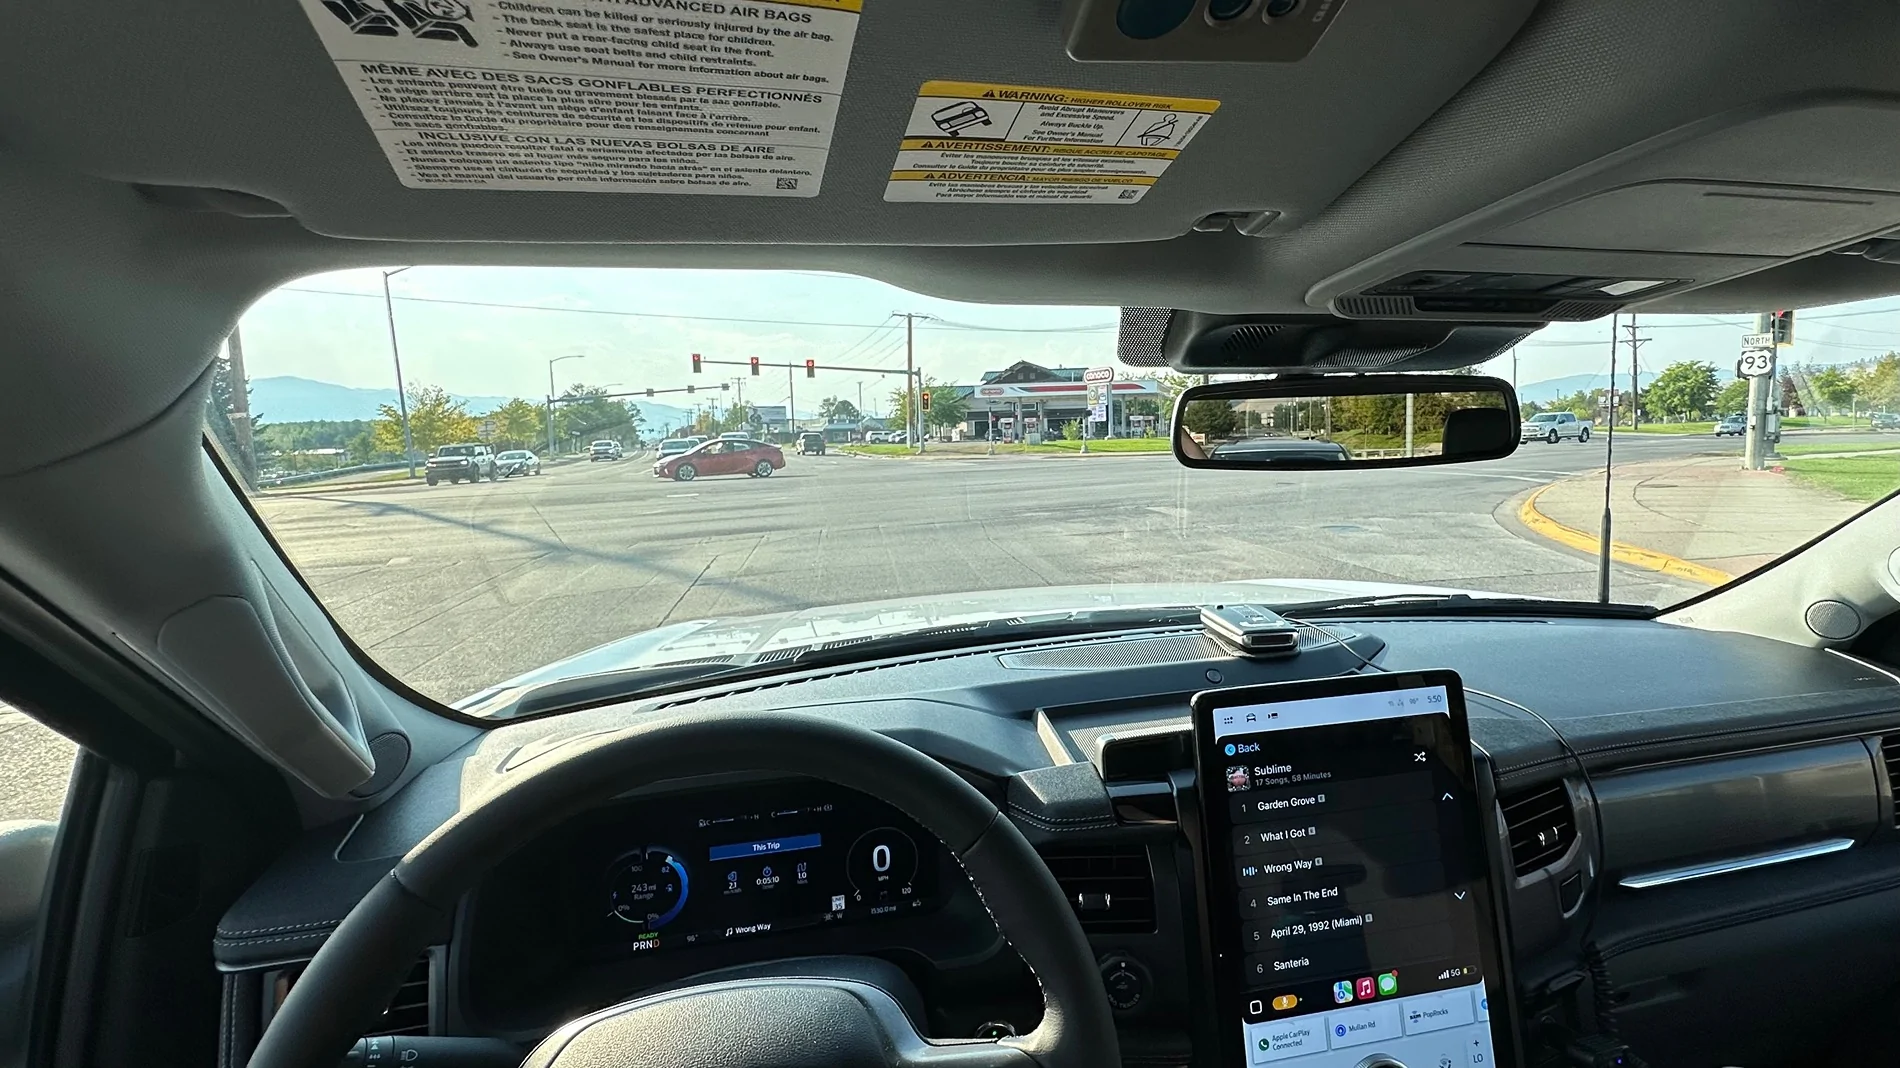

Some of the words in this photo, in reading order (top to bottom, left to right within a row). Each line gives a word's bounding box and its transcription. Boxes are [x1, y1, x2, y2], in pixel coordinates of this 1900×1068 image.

[498, 1, 554, 15] Children
[558, 7, 582, 17] can
[584, 9, 600, 18] be
[604, 12, 638, 22] killed
[658, 18, 710, 30] seriously
[714, 22, 753, 34] injured
[756, 26, 770, 36] by
[772, 28, 790, 38] the
[794, 30, 808, 38] air
[811, 32, 834, 42] bag.
[730, 7, 760, 18] AIR
[764, 9, 812, 24] BAGS
[503, 14, 528, 25] The
[530, 16, 562, 28] back
[566, 20, 594, 30] seat
[596, 22, 608, 32] is
[610, 24, 632, 34] the
[634, 26, 670, 37] safest
[674, 31, 704, 40] place
[708, 33, 724, 42] for
[728, 35, 775, 46] children.
[505, 26, 542, 38] Never
[546, 31, 568, 40] put
[582, 34, 648, 48] rear-facing
[652, 39, 680, 50] child
[683, 44, 708, 52] seat
[710, 45, 722, 53] in
[724, 46, 742, 54] the
[745, 48, 774, 58] front.
[509, 40, 556, 52] Always
[558, 44, 581, 52] use
[584, 46, 610, 55] seat
[612, 48, 642, 58] belts
[645, 51, 666, 60] and
[670, 52, 696, 62] child
[700, 56, 756, 67] restraints.
[512, 51, 536, 60] See
[539, 54, 589, 64] Owner's
[592, 58, 636, 68] Manual
[638, 60, 654, 70] for
[657, 64, 686, 72] more
[689, 65, 751, 77] information
[754, 70, 784, 80] about
[786, 72, 800, 80] air
[802, 74, 830, 84] bags.
[360, 64, 422, 76] MÊME
[426, 68, 478, 80] AVEC
[482, 72, 520, 83] DES
[524, 74, 574, 86] SACS
[578, 78, 692, 94] GONFLABLES
[696, 86, 822, 104] PERFECTIONNÉS
[998, 90, 1068, 103] WARNING:
[1070, 96, 1104, 105] HIGHER
[1104, 99, 1152, 108] ROLLOVER
[1056, 112, 1092, 120] Excessive
[1092, 114, 1115, 122] Speed.
[1061, 106, 1086, 116] Abrupt
[1088, 107, 1125, 116] Maneuvers
[1040, 121, 1068, 129] Always
[1069, 122, 1092, 130] Buckle
[1093, 122, 1104, 130] Up.
[1036, 135, 1064, 143] Further
[1064, 136, 1104, 144] Information
[1047, 130, 1076, 138] Owner's
[418, 131, 510, 142] INCLUSIVE
[514, 135, 550, 144] CON
[554, 137, 586, 146] LAS
[590, 138, 652, 148] NUEVAS
[656, 141, 716, 150] BOLSAS
[743, 146, 776, 154] AIRE
[934, 141, 1050, 153] AVERTISSEMENT:
[938, 172, 1030, 182] ADVERTENCIA:
[1744, 337, 1770, 346] NORTH
[1744, 355, 1768, 370] 93
[1427, 694, 1442, 704] 5:50
[1238, 742, 1260, 754] Back
[1254, 763, 1292, 776] Sublime
[1255, 778, 1264, 787] 17
[1265, 774, 1290, 787] Songs,
[1292, 774, 1302, 782] 58
[1302, 770, 1332, 782] Minutes
[1241, 804, 1247, 812] 1
[1257, 800, 1289, 812] Garden
[1290, 796, 1316, 808] Grove
[1244, 835, 1250, 844] 2
[1260, 831, 1284, 843] What
[1284, 830, 1288, 840] I
[1290, 828, 1306, 838] Got
[752, 842, 768, 852] This
[768, 842, 780, 850] Trip
[872, 844, 891, 872] 0
[661, 866, 670, 874] 82
[1264, 862, 1292, 876] Wrong
[1293, 859, 1312, 872] Way
[756, 876, 780, 886] 0:05:10
[798, 872, 807, 880] 1.0
[632, 882, 648, 894] 243
[728, 882, 737, 890] 2.1
[902, 886, 912, 894] 120
[634, 892, 654, 901] Range
[1250, 898, 1257, 908] 4
[1267, 895, 1292, 907] Same
[1294, 892, 1302, 902] In
[1303, 890, 1320, 900] The
[1321, 887, 1338, 898] End
[735, 924, 756, 934] Wrong
[757, 922, 771, 934] Way
[1254, 932, 1260, 941] 5
[1270, 926, 1291, 940] April
[1292, 924, 1306, 936] 29,
[1308, 920, 1330, 932] 1992
[1332, 914, 1363, 930] (Miami)
[638, 932, 659, 940] READY
[632, 938, 660, 951] PRND
[1257, 964, 1264, 974] 6
[1274, 957, 1310, 972] Santeria
[1450, 968, 1460, 977] 5G
[1422, 1008, 1448, 1019] PopRocks
[1349, 1023, 1366, 1032] Mullan
[1366, 1020, 1376, 1030] Rd
[1272, 1033, 1288, 1044] Apple
[1289, 1028, 1310, 1041] CarPlay
[1272, 1040, 1303, 1050] Connected
[1472, 1053, 1484, 1064] LO
